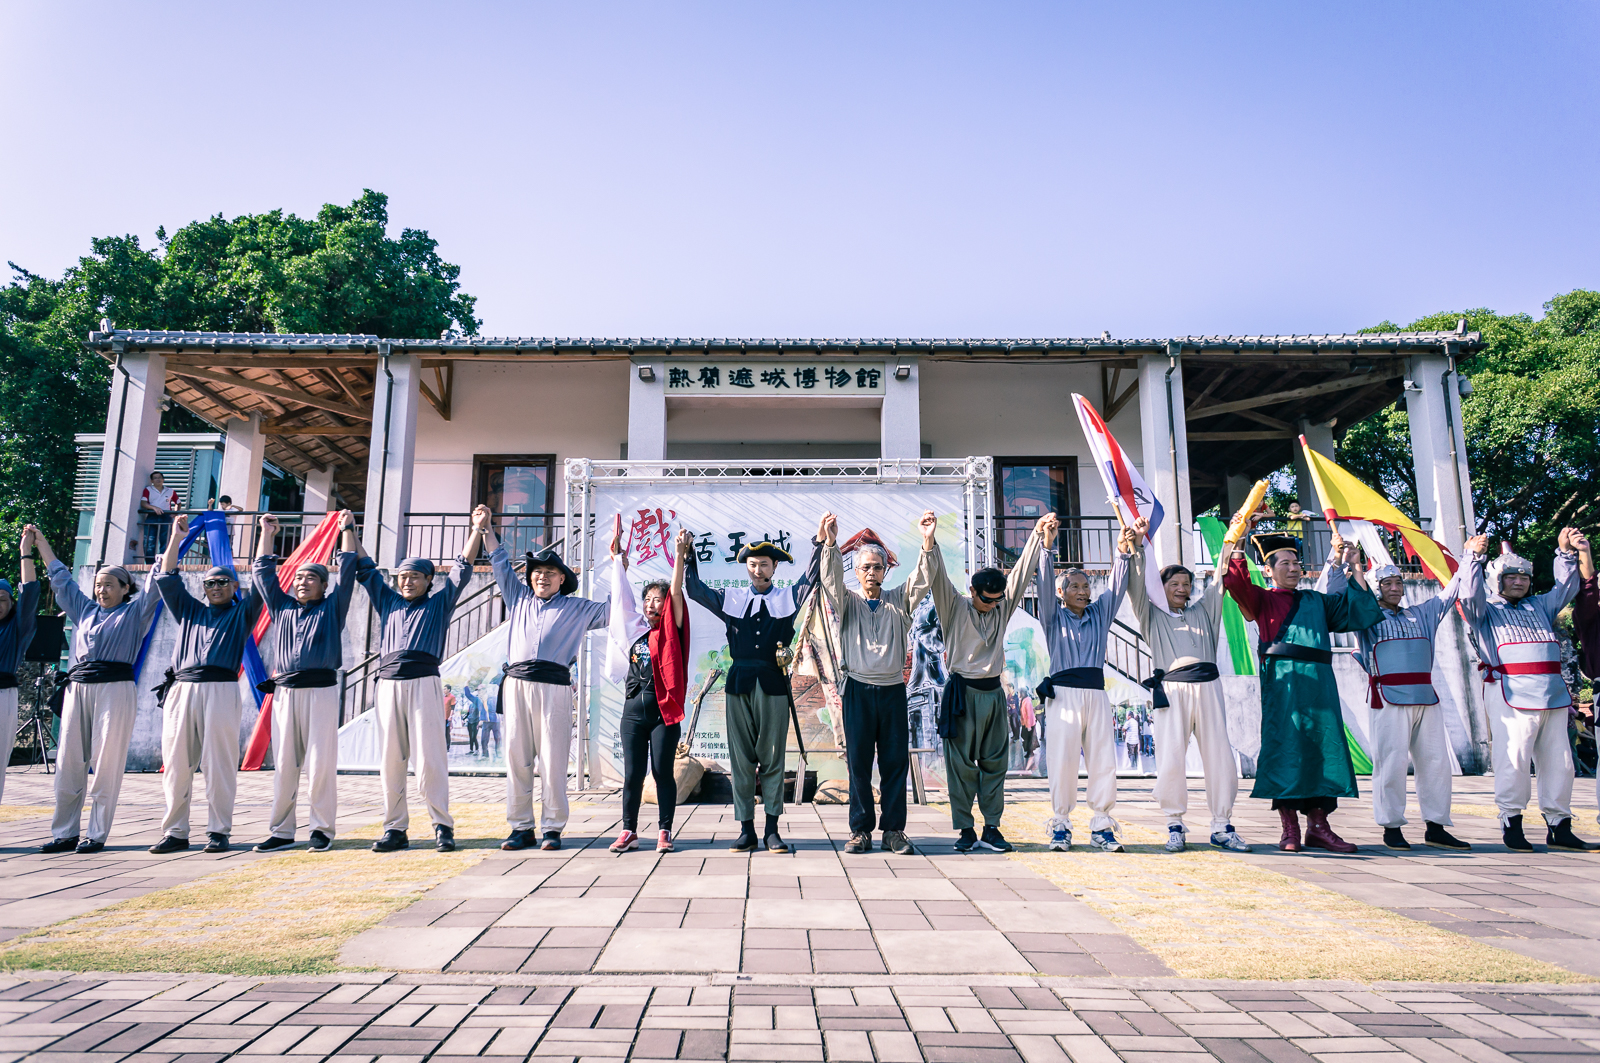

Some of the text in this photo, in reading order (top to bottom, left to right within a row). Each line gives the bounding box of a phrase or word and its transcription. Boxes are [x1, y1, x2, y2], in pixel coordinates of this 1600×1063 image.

[668, 366, 881, 389] 熱蘭遮城博物館
